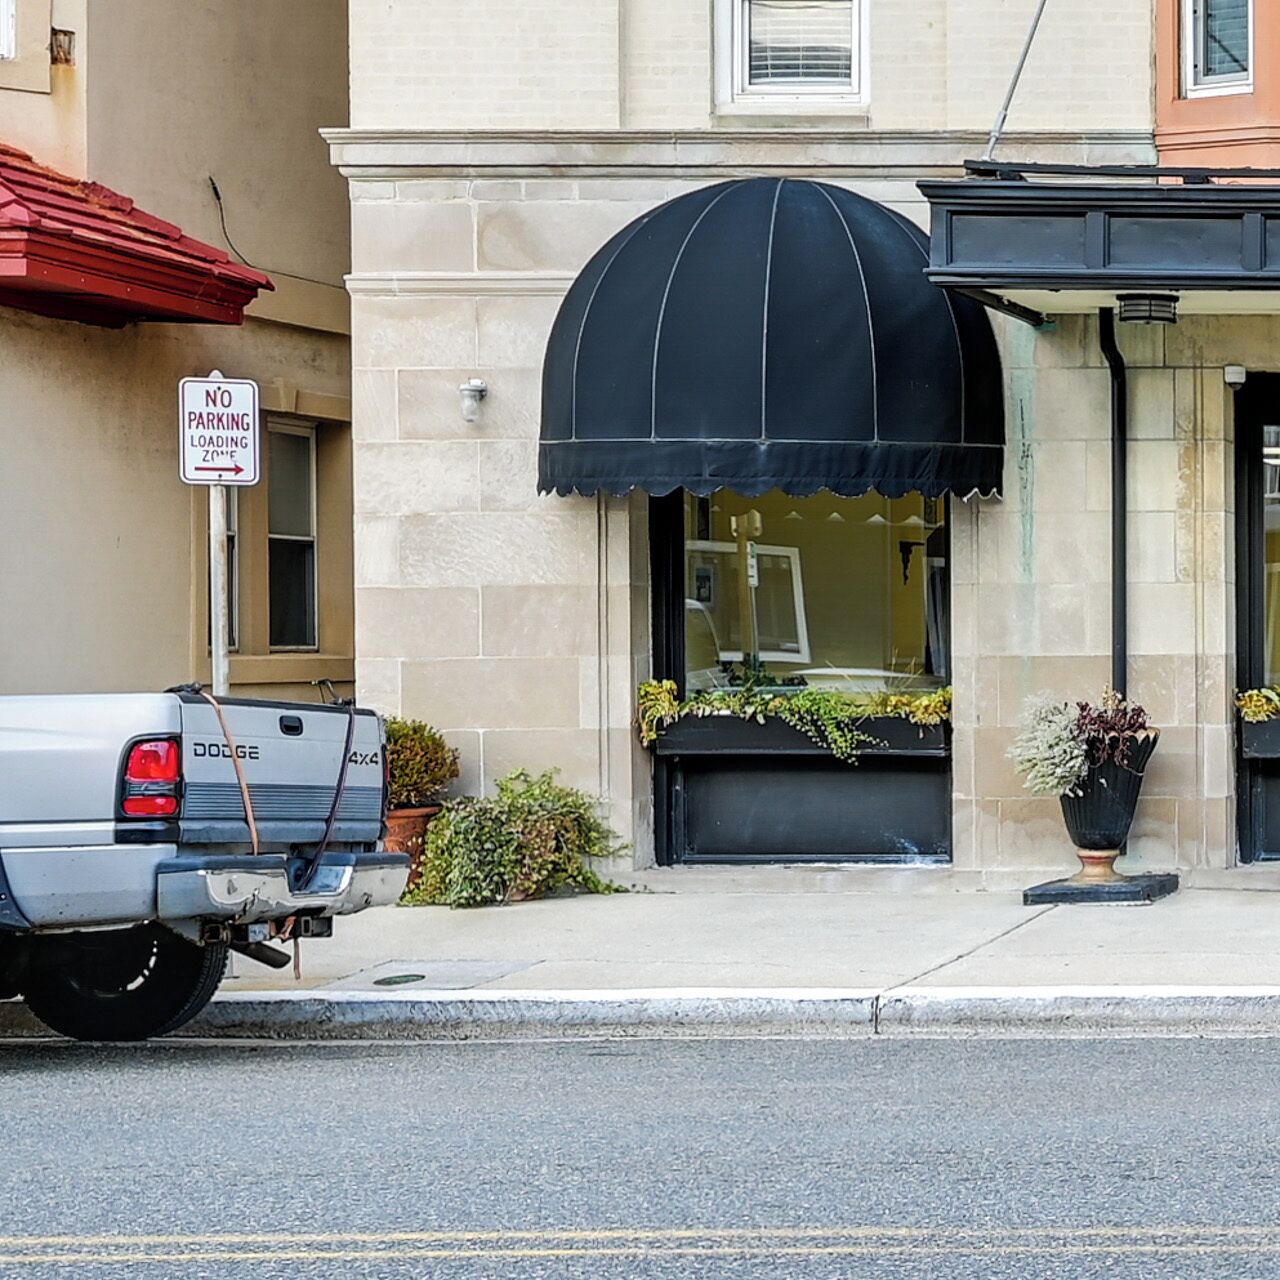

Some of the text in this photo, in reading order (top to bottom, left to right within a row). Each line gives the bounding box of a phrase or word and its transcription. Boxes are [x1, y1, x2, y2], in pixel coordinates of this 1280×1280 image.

[205, 389, 232, 408] NO
[187, 411, 250, 431] PARKING
[190, 435, 248, 449] LOADING
[193, 742, 260, 760] DODGE
